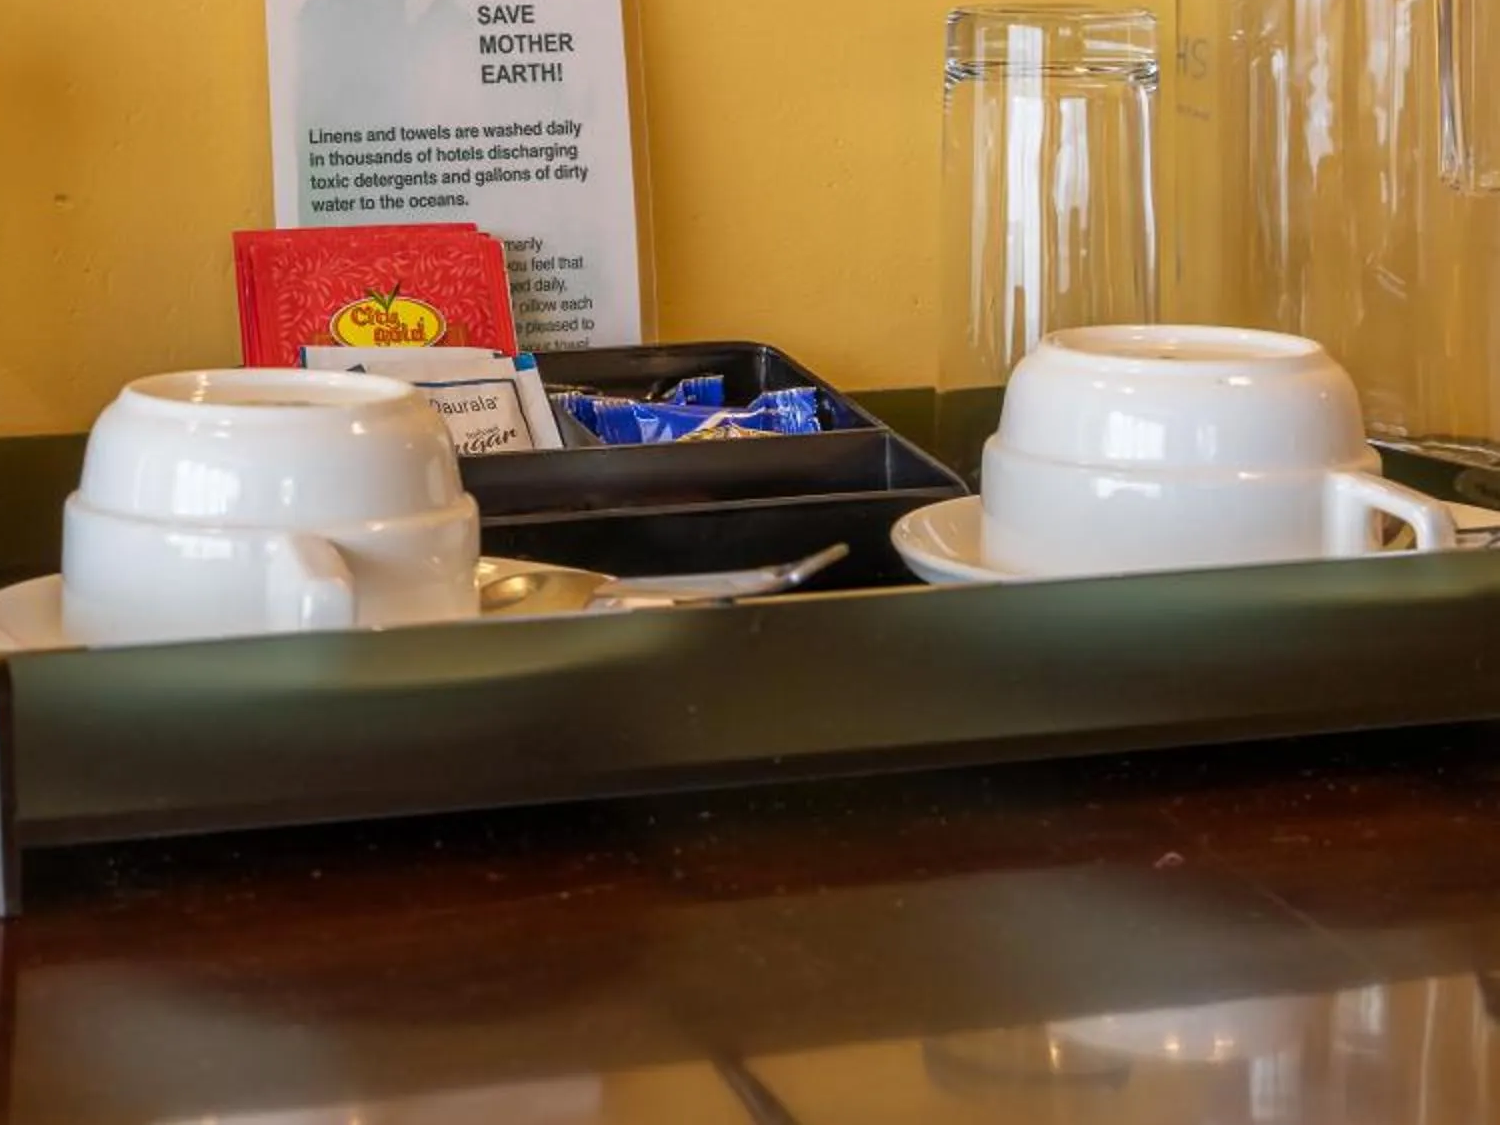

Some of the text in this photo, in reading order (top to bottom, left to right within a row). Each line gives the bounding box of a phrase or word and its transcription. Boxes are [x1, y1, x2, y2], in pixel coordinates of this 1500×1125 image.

[477, 4, 535, 25] SAVE
[479, 32, 575, 54] MOTHER
[481, 62, 563, 84] EARTH!
[308, 119, 582, 144] Linens and towels are washed daily
[309, 142, 579, 167] in thousands of hotels discharging
[310, 164, 589, 190] toxic detergents and gallons of dirty
[311, 193, 469, 213] water to the oceans.
[531, 256, 556, 272] feel
[558, 255, 584, 270] that
[519, 298, 557, 314] pillow
[561, 295, 593, 312] each
[526, 317, 579, 337] pleased
[581, 317, 595, 331] to
[454, 426, 518, 455] ugar
